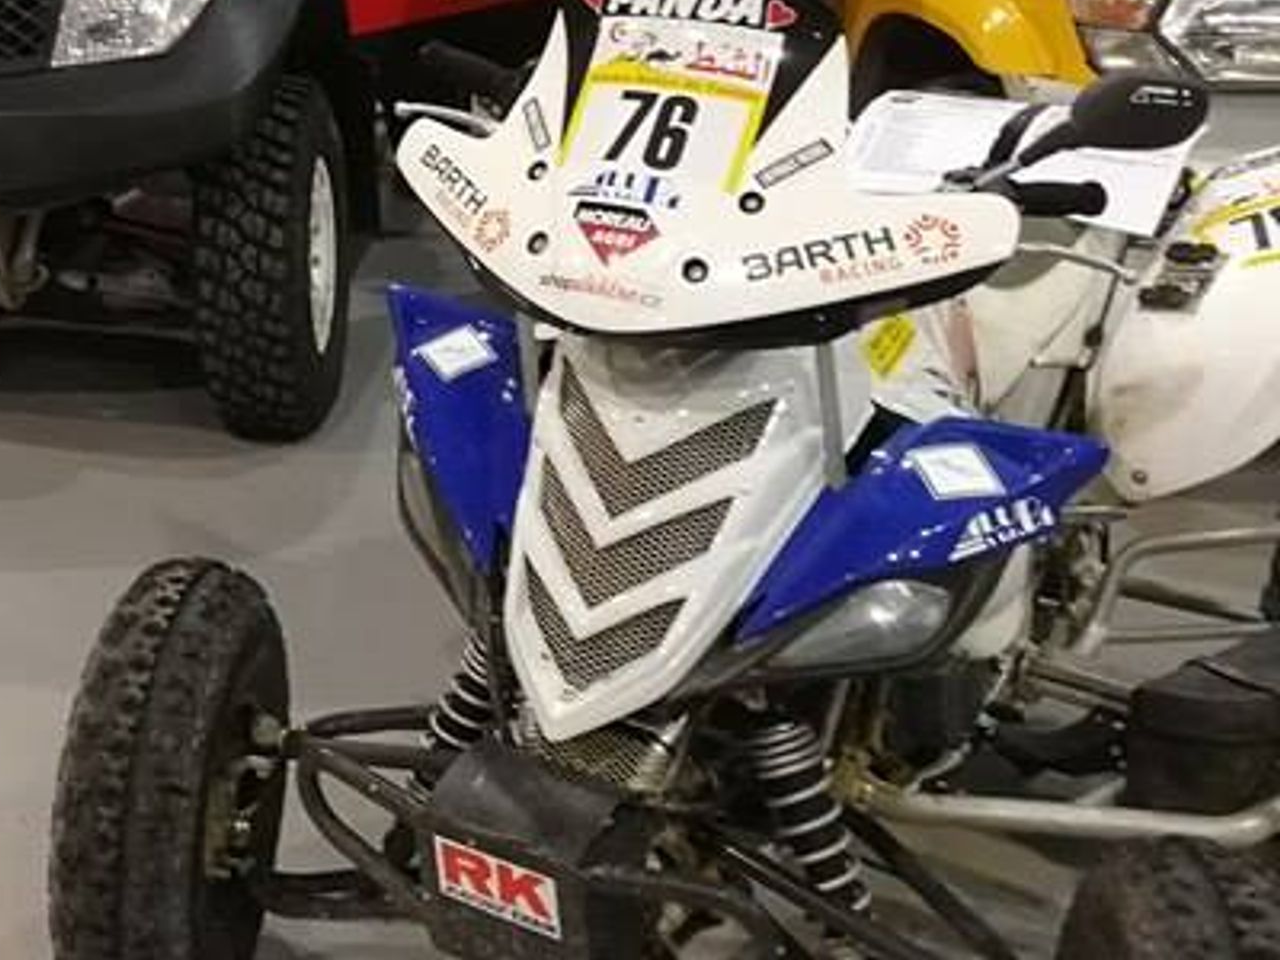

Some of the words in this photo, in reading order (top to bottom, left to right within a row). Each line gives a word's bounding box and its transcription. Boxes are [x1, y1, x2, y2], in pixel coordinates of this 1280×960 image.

[604, 90, 699, 171] 76
[420, 144, 488, 215] BARTH
[440, 841, 553, 922] RK
